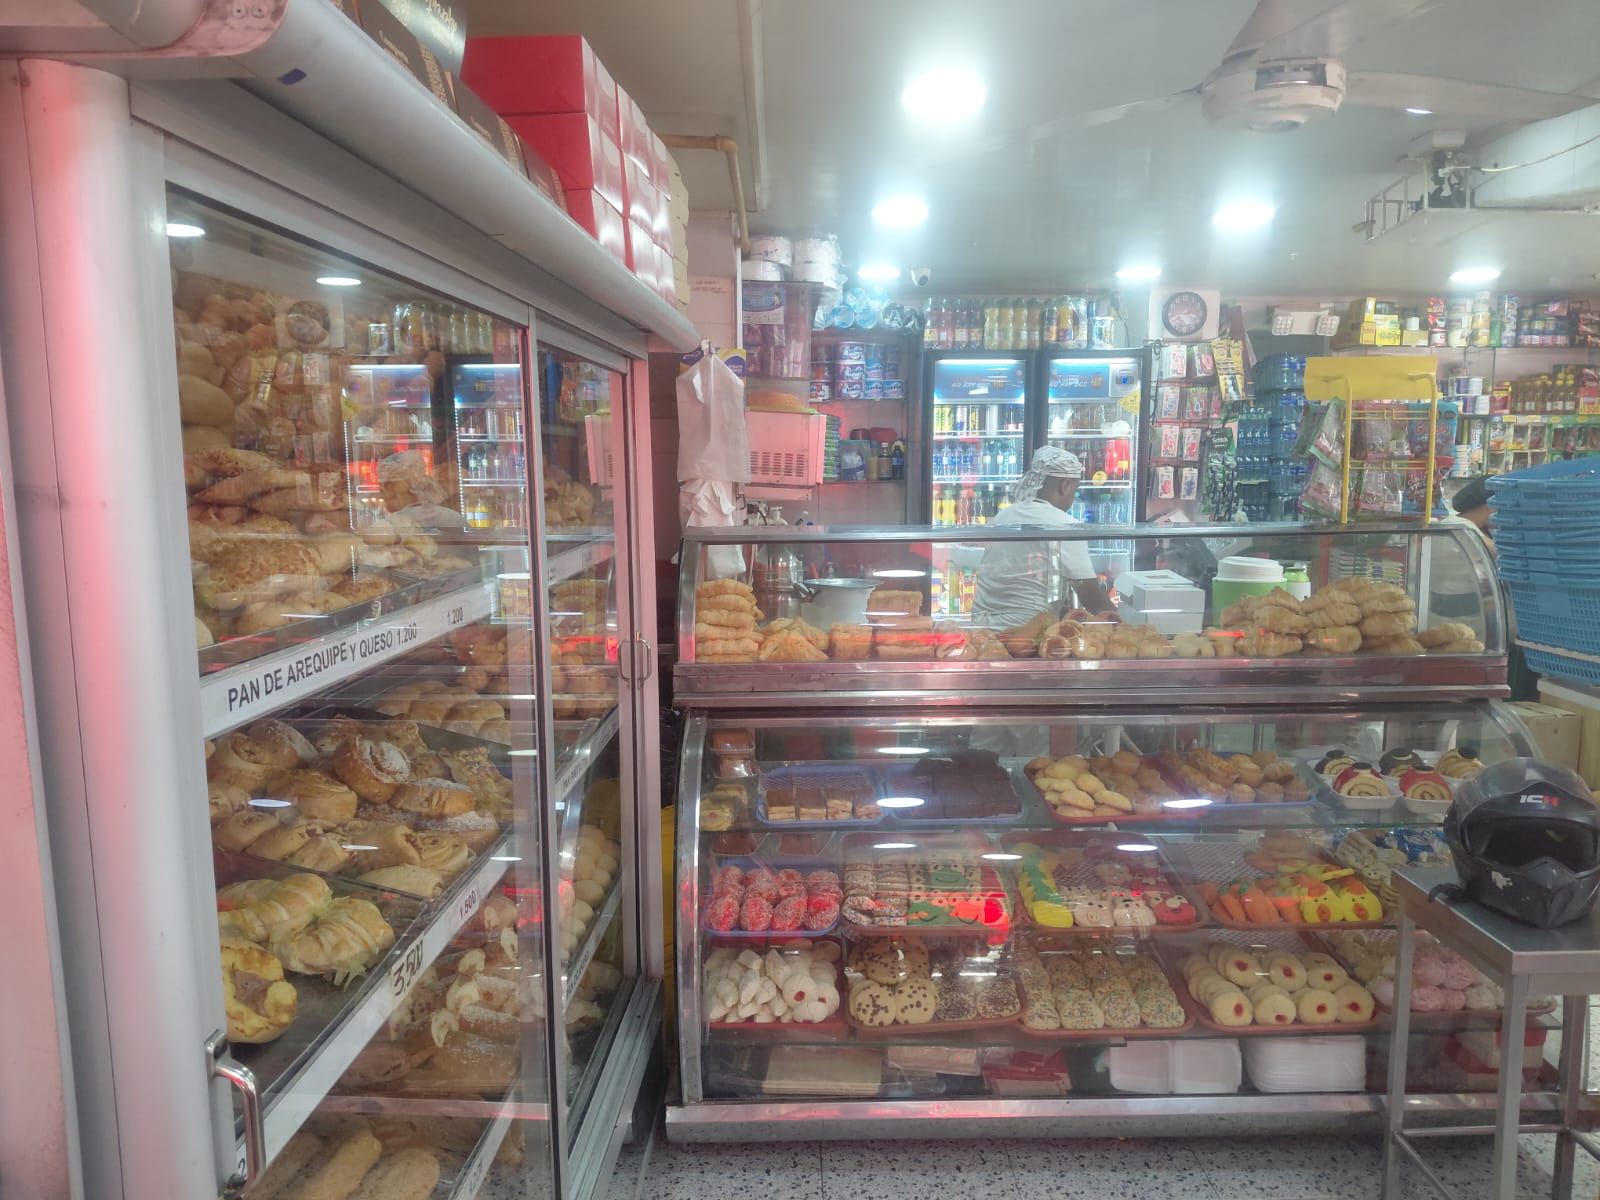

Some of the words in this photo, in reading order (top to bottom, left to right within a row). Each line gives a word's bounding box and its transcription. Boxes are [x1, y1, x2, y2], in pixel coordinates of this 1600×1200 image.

[446, 606, 464, 627] 1.200
[228, 678, 261, 712] PAN
[264, 664, 284, 696] DE
[287, 641, 349, 687] AREQUIPE
[349, 642, 357, 664] Y
[358, 630, 394, 658] QUESO
[396, 622, 419, 646] 1.200
[459, 890, 477, 921] 1.500
